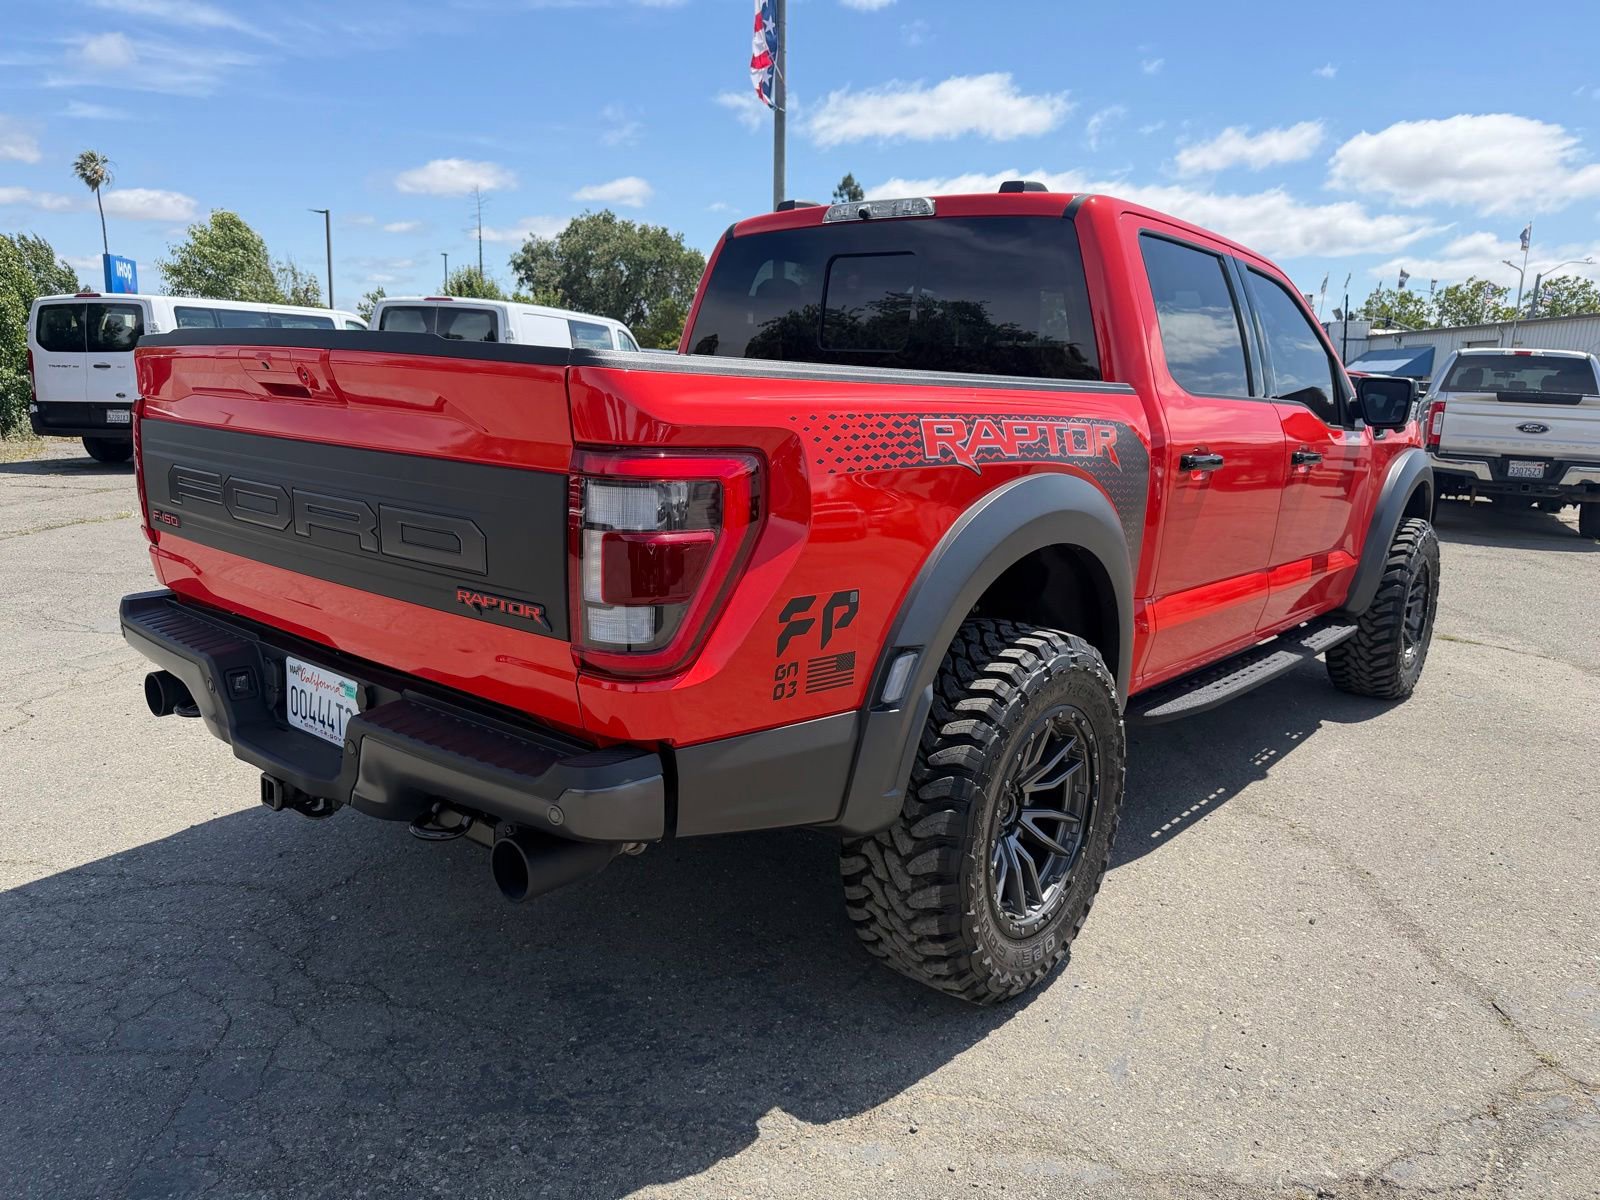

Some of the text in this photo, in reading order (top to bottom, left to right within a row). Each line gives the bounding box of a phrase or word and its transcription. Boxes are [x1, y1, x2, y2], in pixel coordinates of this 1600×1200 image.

[920, 419, 1122, 475] RAPTOR
[153, 510, 178, 526] F-150
[168, 463, 488, 576] FORD
[457, 588, 552, 630] RAPTOR
[301, 667, 345, 697] California
